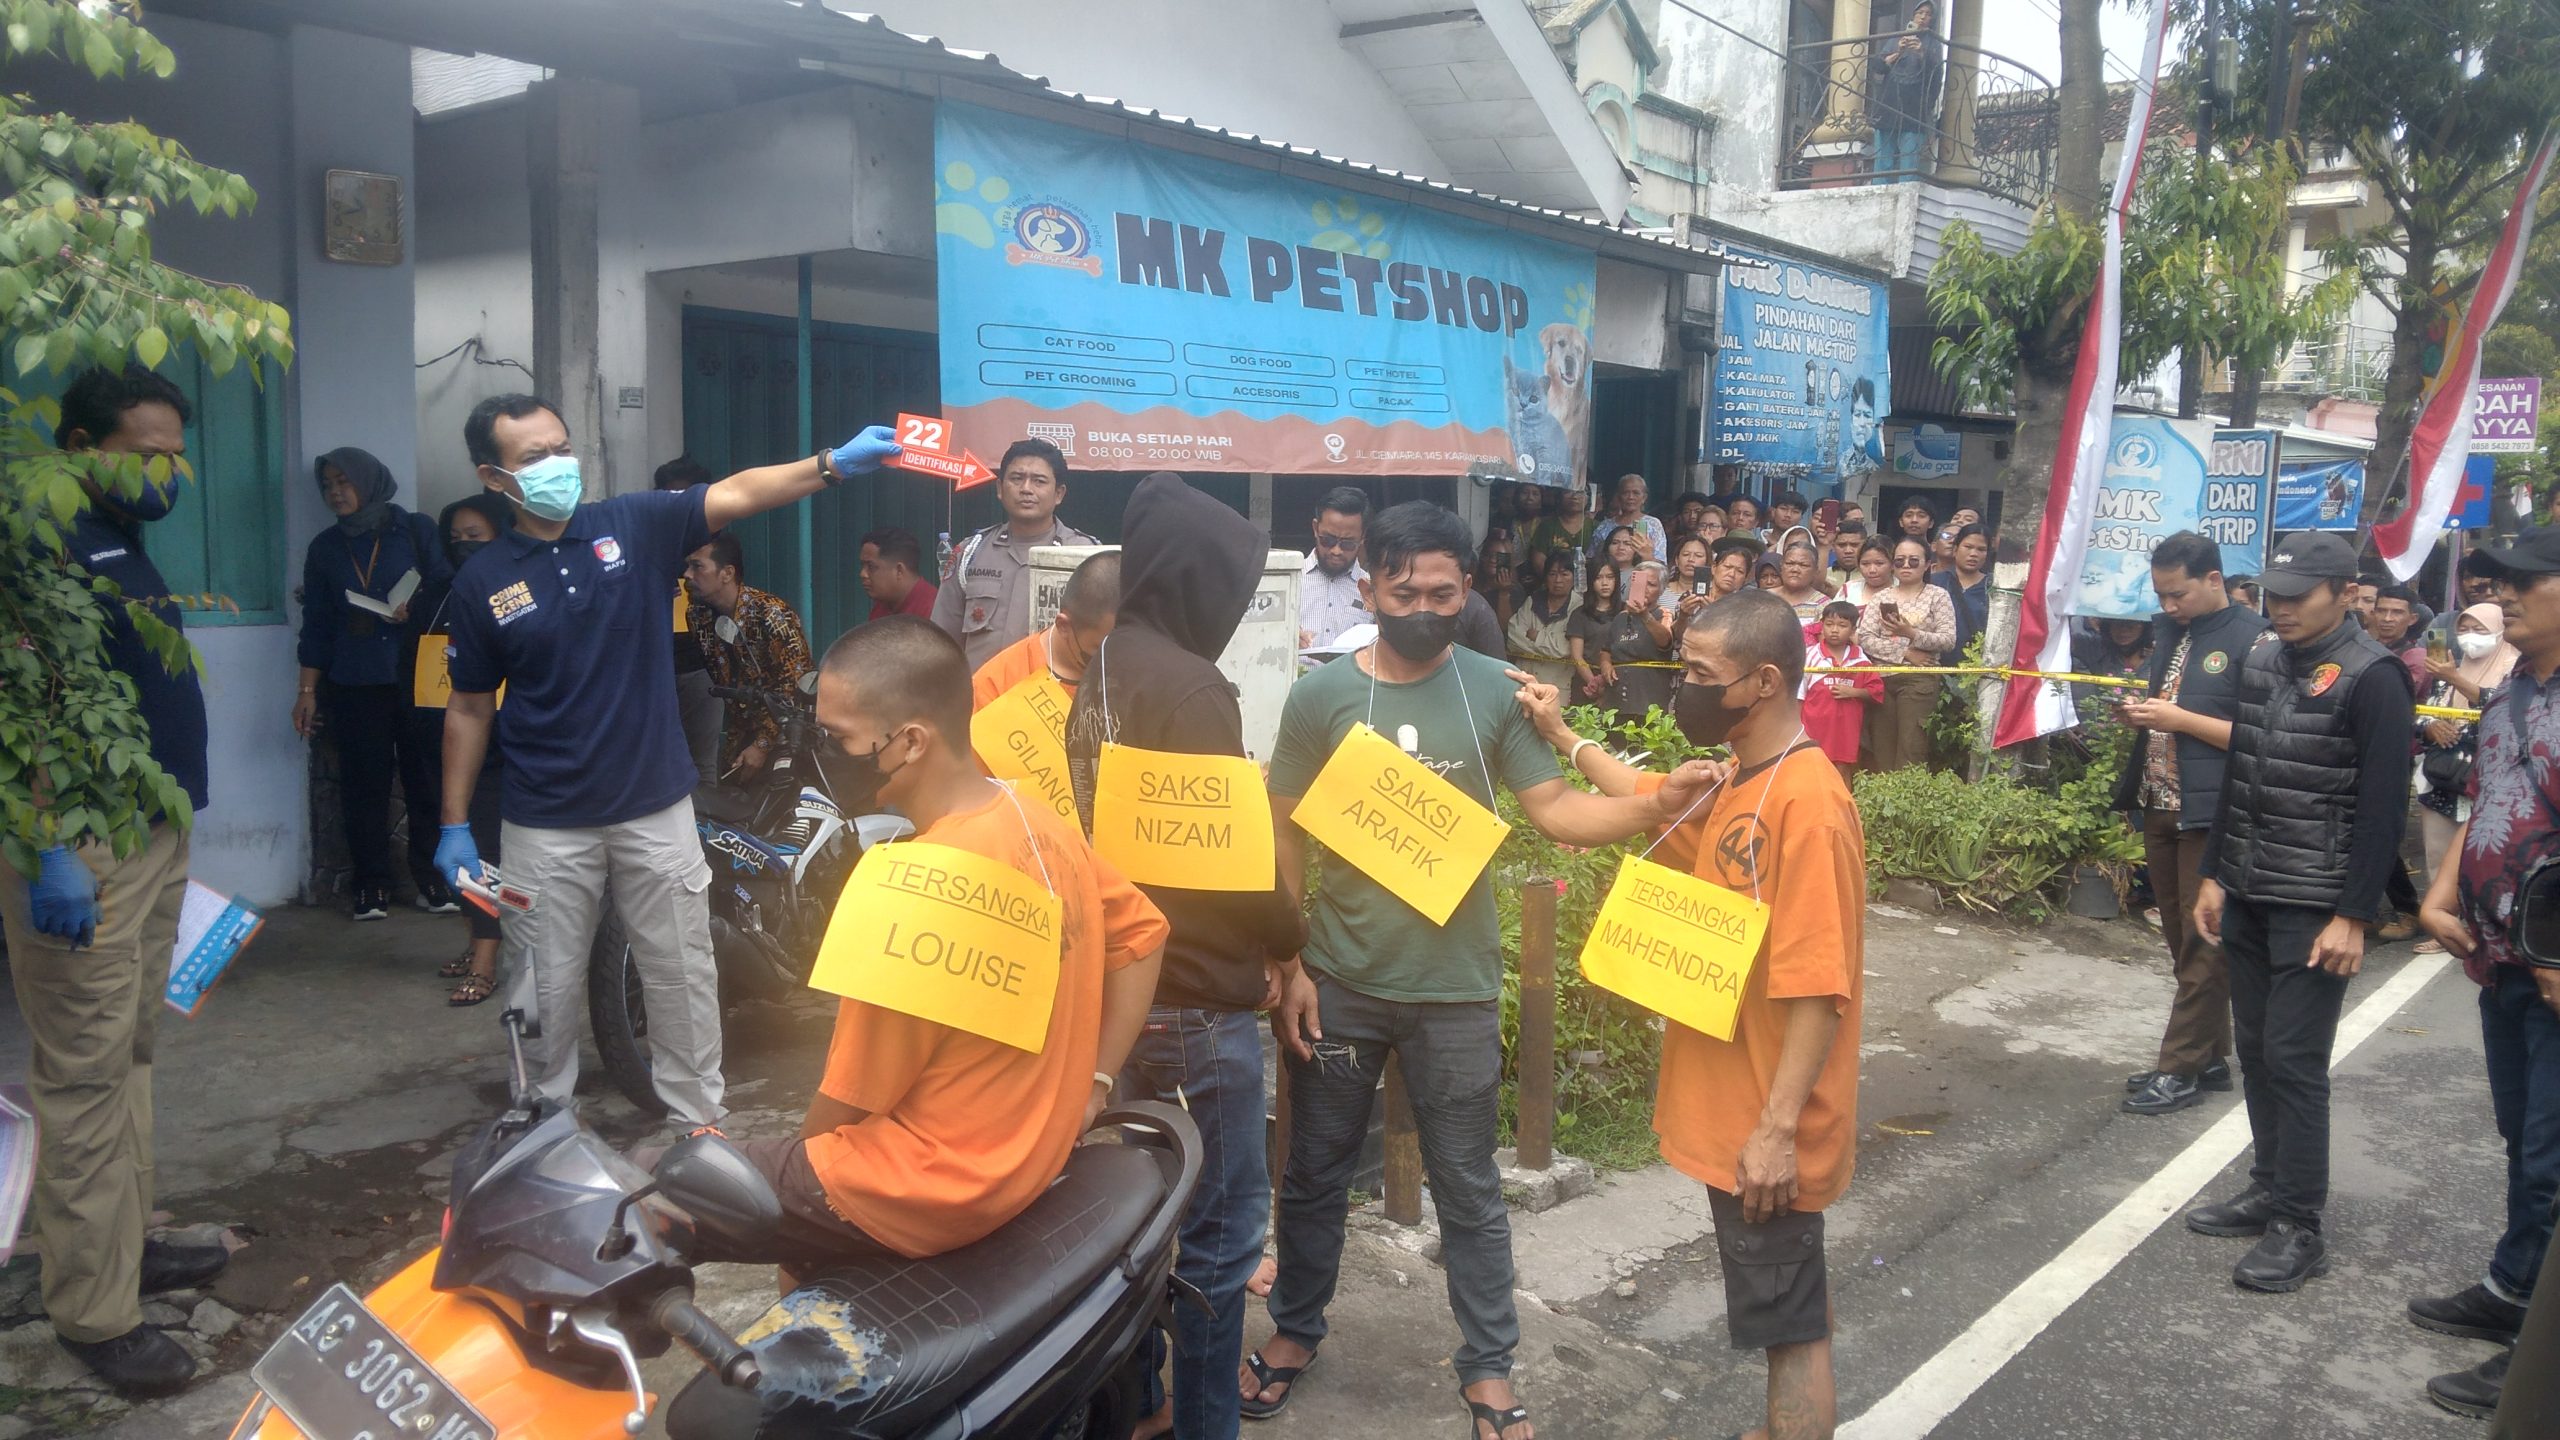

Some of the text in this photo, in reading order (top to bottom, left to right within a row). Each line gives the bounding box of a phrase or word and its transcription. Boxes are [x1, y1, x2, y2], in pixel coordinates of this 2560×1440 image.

[1113, 211, 1529, 339] MK PETSHOP
[1754, 303, 1857, 342] PINDAHAN DARI
[1044, 336, 1116, 352] CAT FOOD
[1753, 328, 1857, 363] JALAN MASTRIP
[1230, 355, 1292, 369] DOG FOOD
[1727, 355, 1753, 366] JAM
[1024, 370, 1137, 388] PET GROOMING
[1364, 367, 1421, 380] PET HOTEL
[1760, 374, 1787, 385] MATA
[1232, 386, 1301, 400] ACCESORIS
[1725, 386, 1796, 401] KALKULATOR
[2479, 383, 2526, 393] ESANAN
[1724, 402, 1759, 412] GANTI
[1763, 404, 1805, 416] BATERAI
[902, 419, 943, 450] 22
[1723, 417, 1783, 429] AKSESORIS
[1088, 431, 1232, 447] BUKA SETIAP HARI
[1755, 433, 1780, 443] AKIK
[2471, 442, 2490, 450] 0858
[2491, 442, 2510, 450] 5432
[904, 451, 963, 474] IDENTIFIKASI
[1194, 449, 1222, 461] WIB
[1912, 461, 1933, 471] blue
[2094, 486, 2161, 523] MK
[2207, 482, 2258, 512] DARI
[603, 559, 626, 572] INAFIS
[488, 580, 529, 606] CRIME
[492, 591, 534, 619] SCENE
[498, 602, 538, 626] INVESTIGATION
[1007, 729, 1076, 817] GILANG
[1138, 771, 1231, 803] SAKSI
[799, 800, 840, 818] SUZUKI
[1376, 766, 1462, 836] SAKSI
[1135, 816, 1232, 849] NIZAM
[1341, 799, 1445, 878] ARAFIK
[712, 830, 769, 870] SATRIA
[886, 860, 1051, 938] TERSANGKA
[1629, 878, 1747, 941] TERSANGKA
[883, 922, 1027, 997] LOUISE
[1600, 918, 1741, 1001] MAHENDRA
[345, 1338, 430, 1428] 3062
